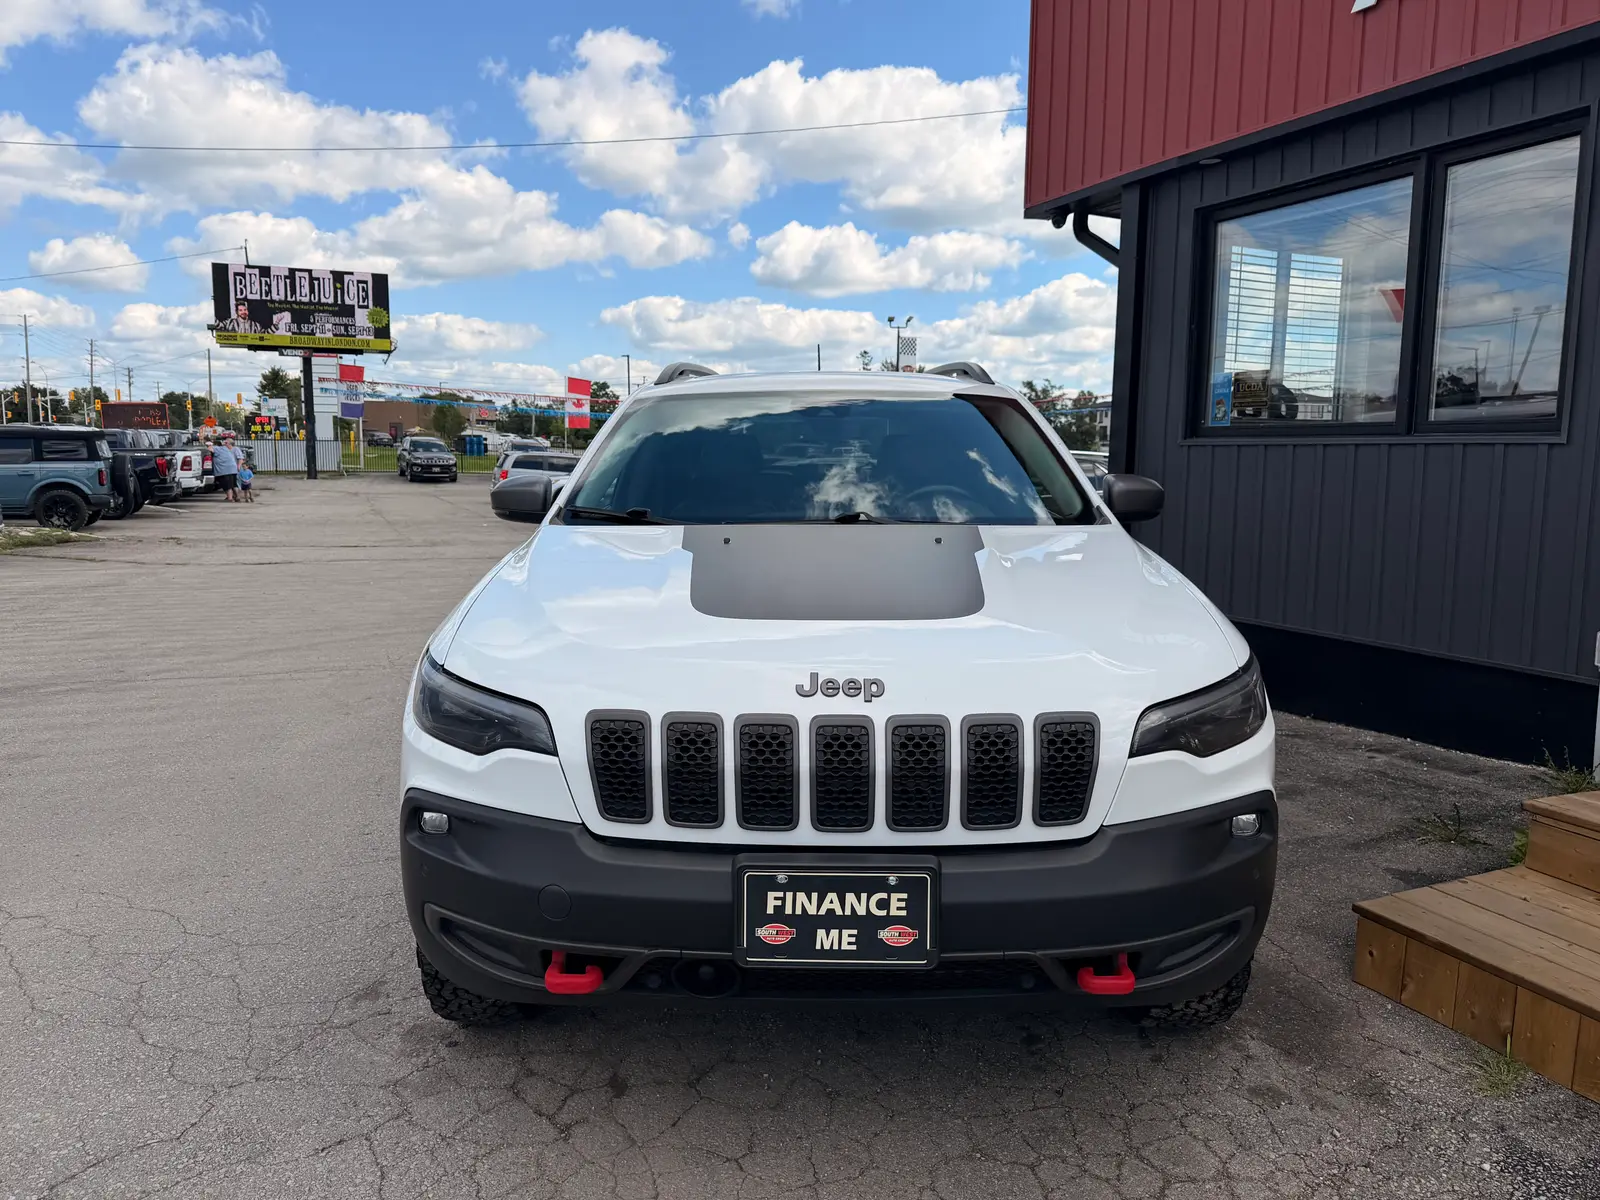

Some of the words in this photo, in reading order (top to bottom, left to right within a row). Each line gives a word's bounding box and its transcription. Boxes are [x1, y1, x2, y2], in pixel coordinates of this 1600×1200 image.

[315, 315, 356, 325] PERFORMANCES
[301, 324, 317, 333] SEPT
[319, 324, 326, 334] 11
[348, 326, 364, 335] SEPT
[365, 327, 374, 336] 13
[289, 335, 371, 348] BROADWAYINLONDON.COM
[1239, 382, 1263, 391] UCDA
[795, 672, 885, 702] Jeep
[766, 891, 908, 916] FINANCE
[815, 928, 858, 950] ME
